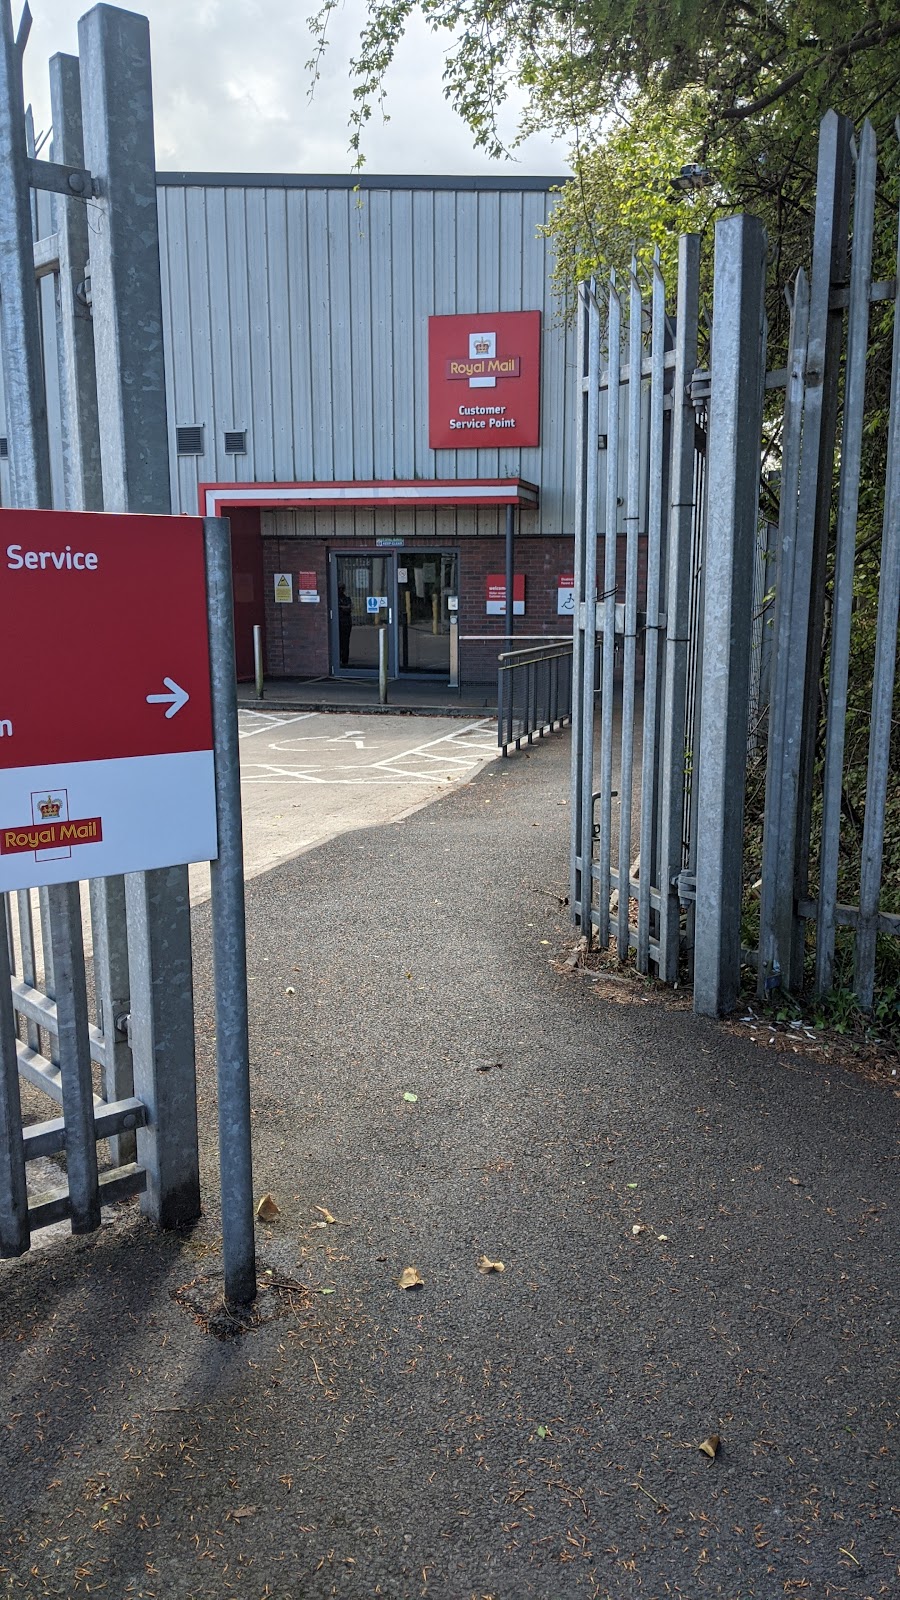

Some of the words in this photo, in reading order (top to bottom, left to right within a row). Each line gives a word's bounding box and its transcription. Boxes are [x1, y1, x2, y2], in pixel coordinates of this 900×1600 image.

[450, 361, 485, 376] Royal
[487, 359, 515, 373] Mail
[458, 405, 506, 416] Customer
[449, 418, 486, 429] Service
[488, 417, 516, 429] Point
[6, 544, 99, 571] Service
[4, 825, 56, 850] Royal
[59, 822, 97, 841] Mail
